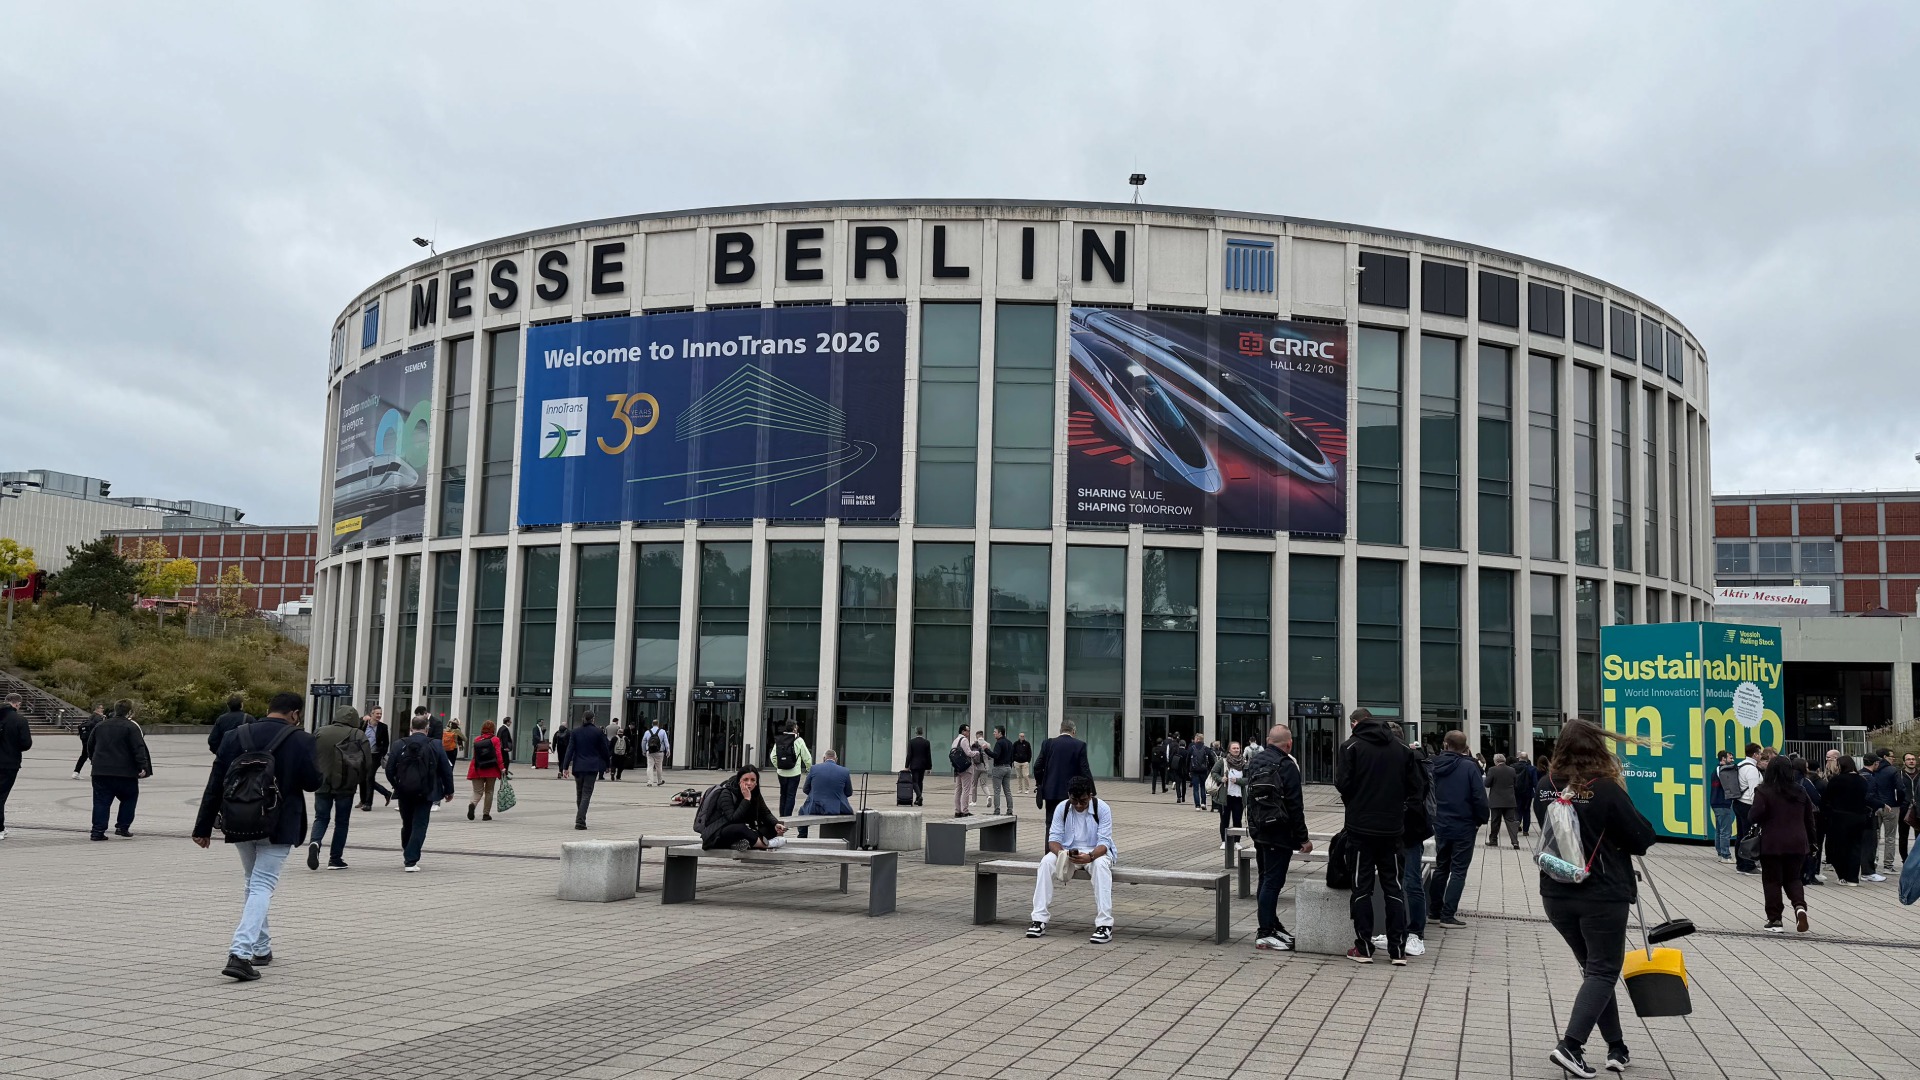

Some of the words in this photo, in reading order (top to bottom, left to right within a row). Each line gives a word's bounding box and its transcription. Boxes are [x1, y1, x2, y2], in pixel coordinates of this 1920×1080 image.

[410, 242, 625, 329] MESSE
[714, 225, 1126, 284] BERLIN
[544, 345, 642, 369] Welcome
[649, 341, 674, 360] to
[683, 335, 807, 358] InnoTrans
[816, 332, 880, 353] 2026
[1270, 338, 1334, 359] CRRC
[405, 361, 427, 373] SIEMENS
[1270, 360, 1294, 371] HALL
[1297, 362, 1310, 372] 4.2
[1318, 364, 1334, 373] 210
[545, 402, 583, 415] InnoTrans
[597, 392, 660, 454] 30
[1078, 488, 1127, 499] SHARING
[1129, 489, 1166, 501] VALUE,
[1078, 502, 1126, 513] SHAPING
[1129, 503, 1193, 515] TOMORROW
[1720, 588, 1750, 599] Aktiv
[1752, 591, 1808, 605] Messebau
[1740, 637, 1758, 646] Rolling
[1759, 638, 1775, 646] Stock
[1603, 652, 1782, 689] Sustainability
[1624, 689, 1650, 697] World
[1651, 688, 1699, 697] Innovation:
[1706, 689, 1734, 698] Modula
[1604, 689, 1663, 757] in
[1689, 706, 1783, 758] mo
